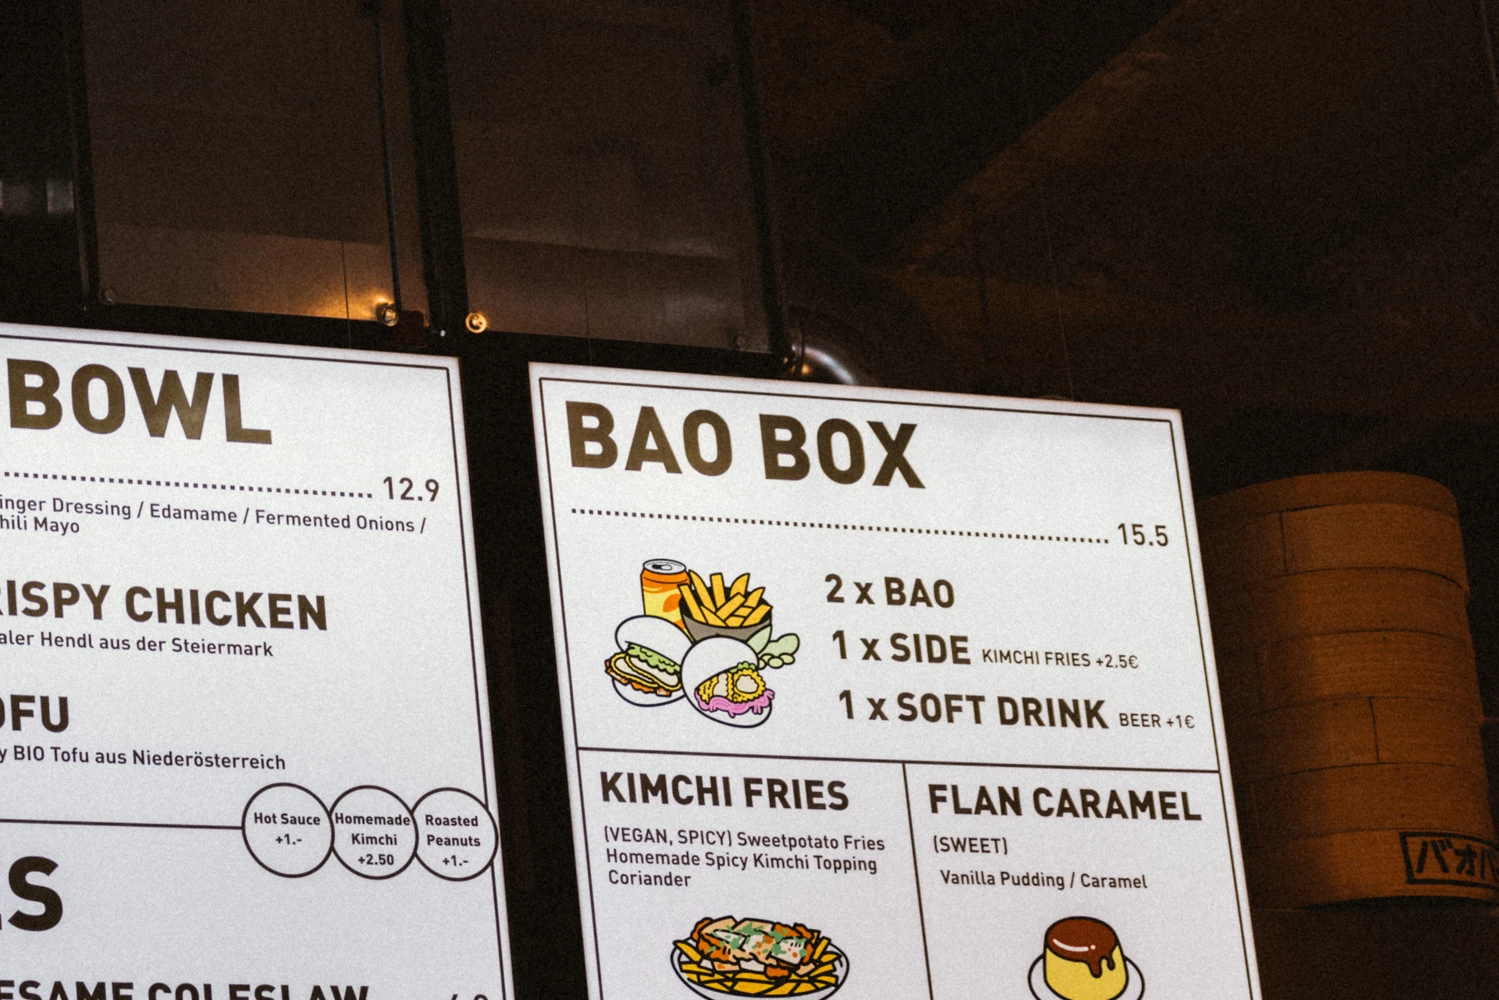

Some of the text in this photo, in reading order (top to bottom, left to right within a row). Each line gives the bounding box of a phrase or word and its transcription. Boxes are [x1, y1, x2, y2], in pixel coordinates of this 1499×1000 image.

[6, 357, 273, 445] BOWL
[565, 400, 926, 490] BAO BOX
[382, 475, 440, 503] 12.9
[33, 515, 81, 537] Mayo
[51, 496, 132, 521] Dressing
[149, 502, 238, 524] Edamame
[254, 508, 352, 530] Fermented
[355, 514, 416, 533] Onions
[1117, 522, 1170, 548] 15.5
[824, 572, 955, 609] 2 x BAO
[124, 585, 328, 632] CHICKEN
[40, 630, 94, 649] Hendl
[98, 637, 132, 651] aus
[135, 635, 167, 652] der
[171, 636, 274, 657] Steiermark
[831, 629, 848, 660] 1
[859, 637, 882, 662] x
[889, 631, 972, 666] SIDE
[981, 648, 1041, 666] KIMCHI
[1043, 650, 1092, 668] FRIES
[838, 689, 855, 720] 1
[866, 697, 889, 722] x
[896, 691, 986, 725] SOFT
[996, 695, 1110, 730] DRINK
[1118, 711, 1162, 729] BEER
[12, 744, 46, 762] BIO
[49, 745, 90, 764] Tofu
[94, 751, 128, 765] aus
[132, 749, 287, 771] Niederösterreich
[599, 770, 850, 812] KIMCHI FRIES
[927, 783, 1203, 822] FLAN CARAMEL
[253, 811, 322, 826] Hot Sauce
[334, 811, 411, 827] Homemade
[424, 813, 479, 828] Roasted
[275, 832, 303, 846] +1.-
[350, 832, 398, 846] Kimchi
[426, 833, 482, 848] Peanuts
[676, 828, 733, 848] SPICY)
[736, 830, 840, 852] Sweetpotato
[842, 834, 886, 852] Fries
[932, 834, 1009, 856] (SWEET)
[357, 852, 395, 867] +2.50
[442, 854, 469, 867] +1.-
[605, 847, 878, 876] Homemade Spicy Kimchi Topping
[607, 868, 692, 888] Coriander
[939, 868, 1149, 892] Vanilla Pudding Caramel
